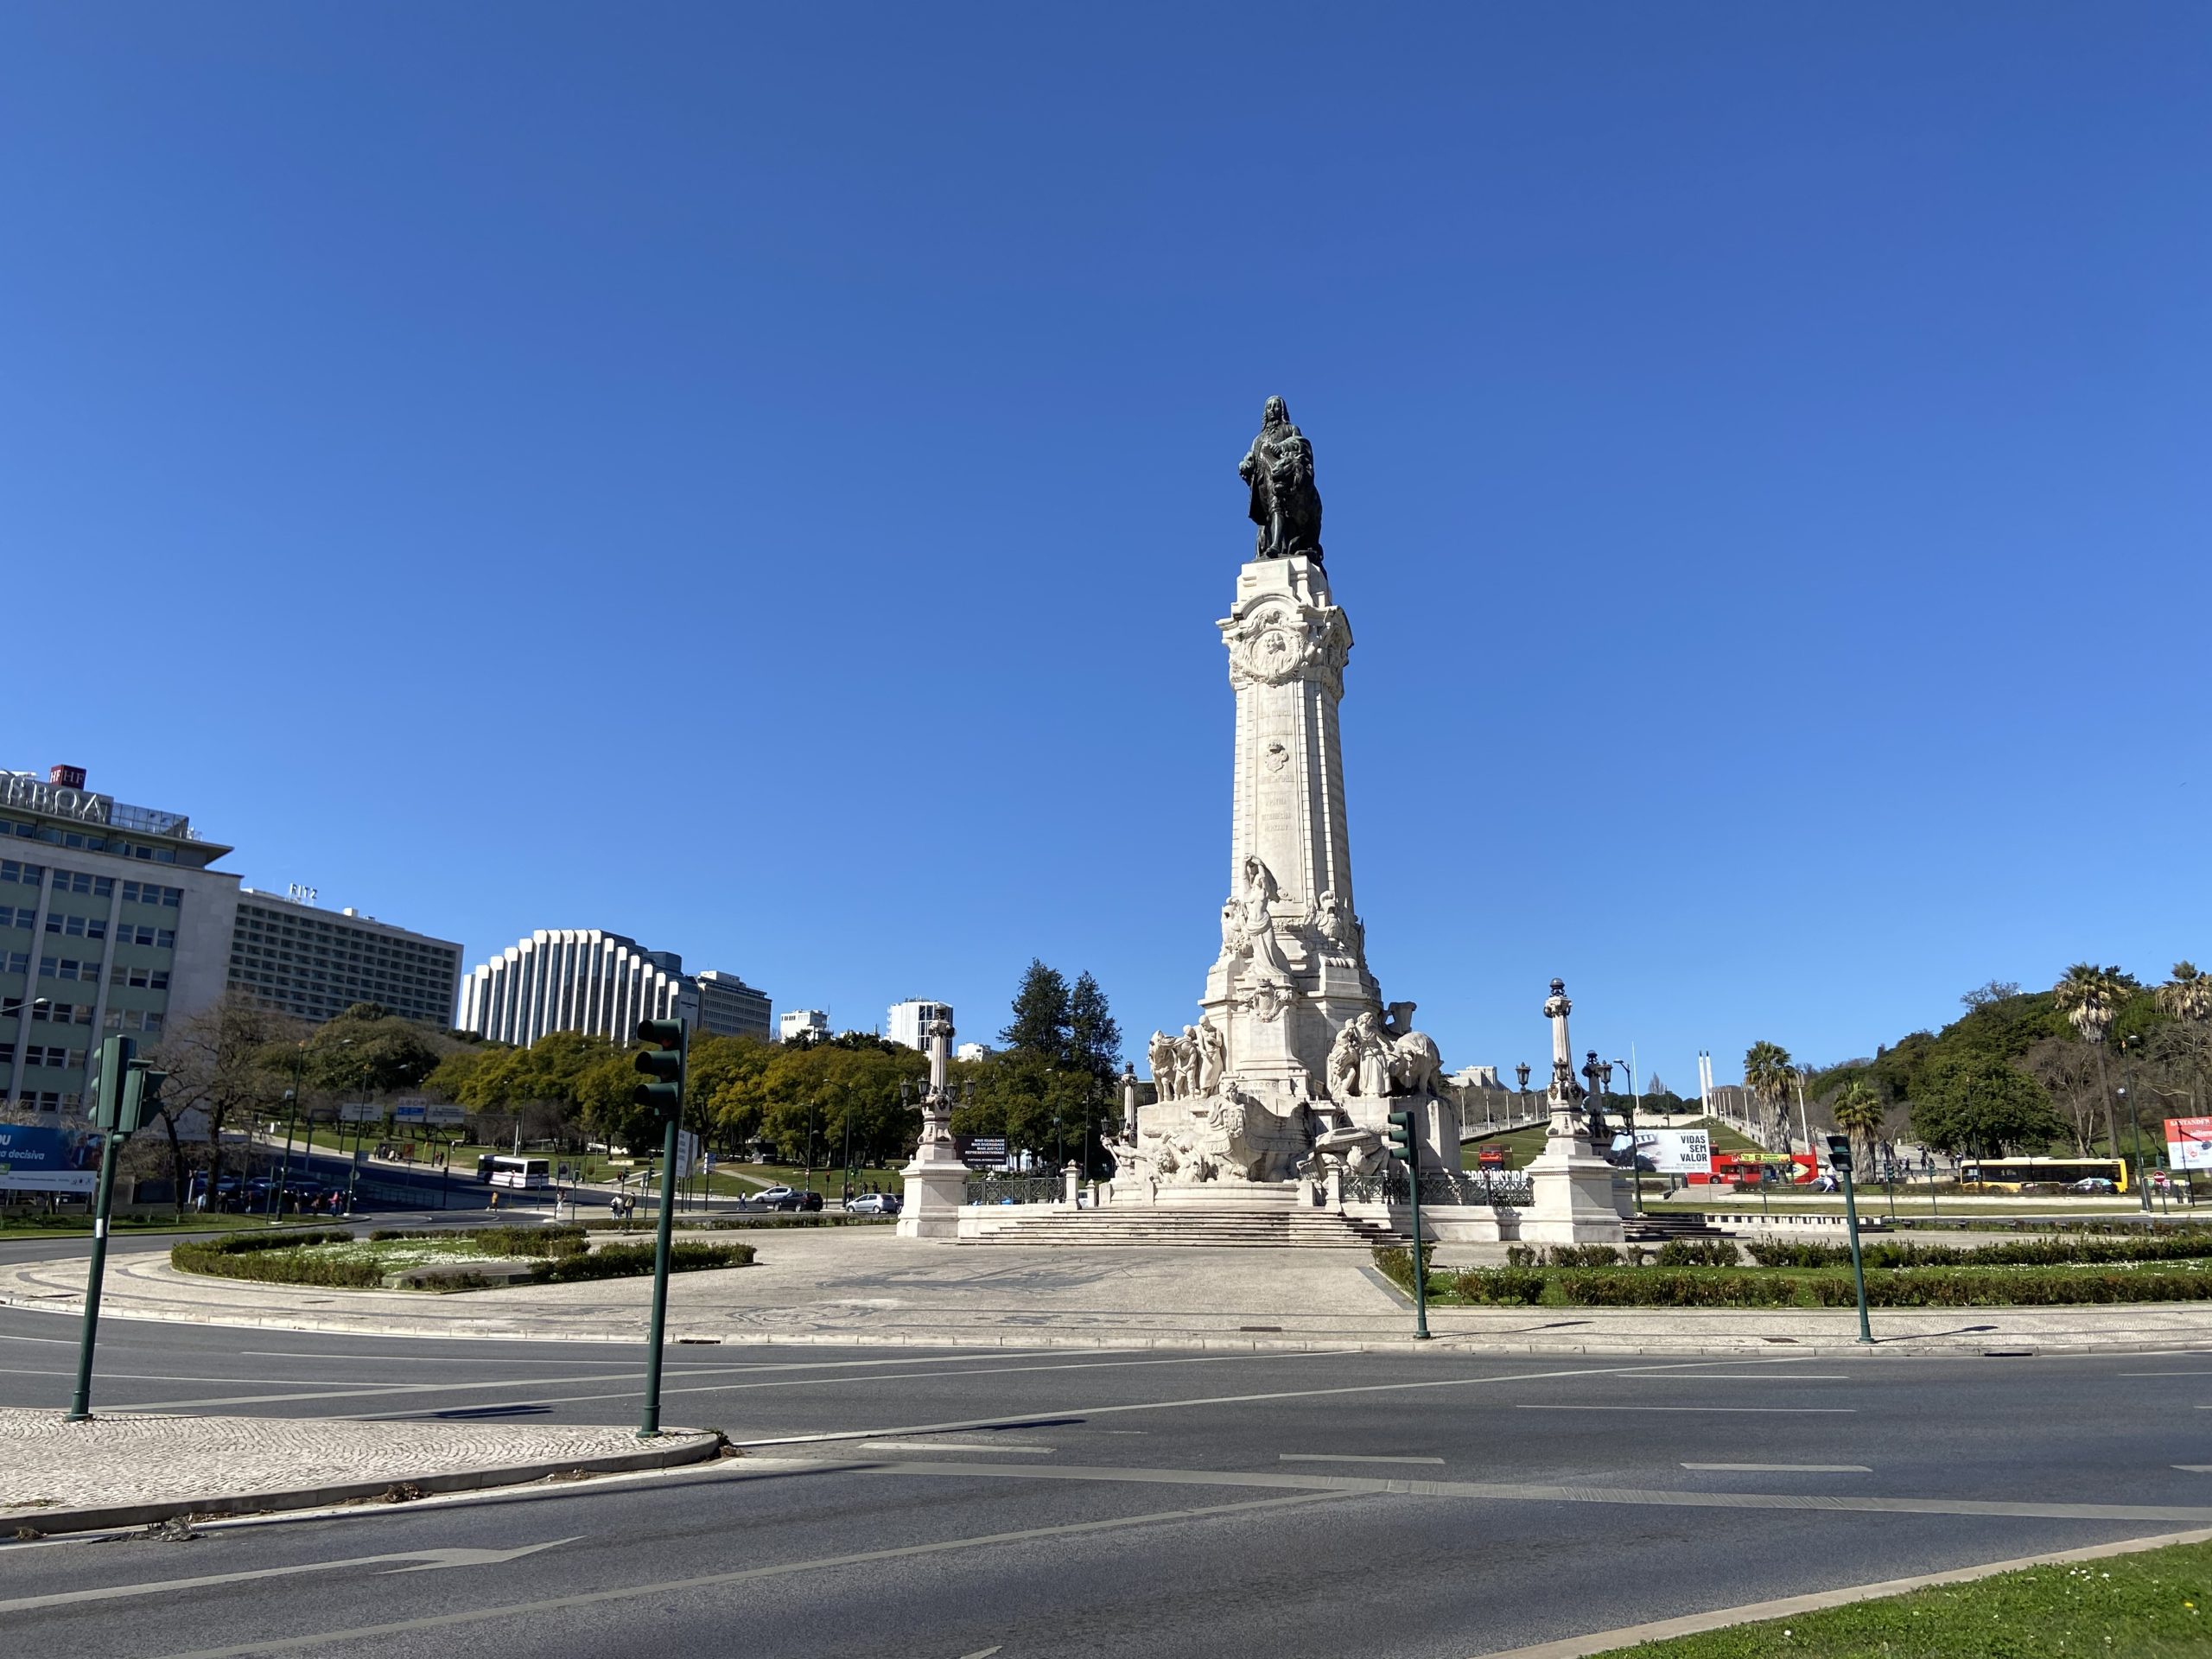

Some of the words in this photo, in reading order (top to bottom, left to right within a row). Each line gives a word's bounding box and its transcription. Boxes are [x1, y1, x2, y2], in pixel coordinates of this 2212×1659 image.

[50, 770, 61, 783] HF
[64, 770, 85, 784] HF
[290, 882, 318, 899] RITZ
[1681, 1135, 1706, 1144] VIDAS
[9, 1149, 45, 1160] decisiva
[1680, 1154, 1707, 1162] VALOR
